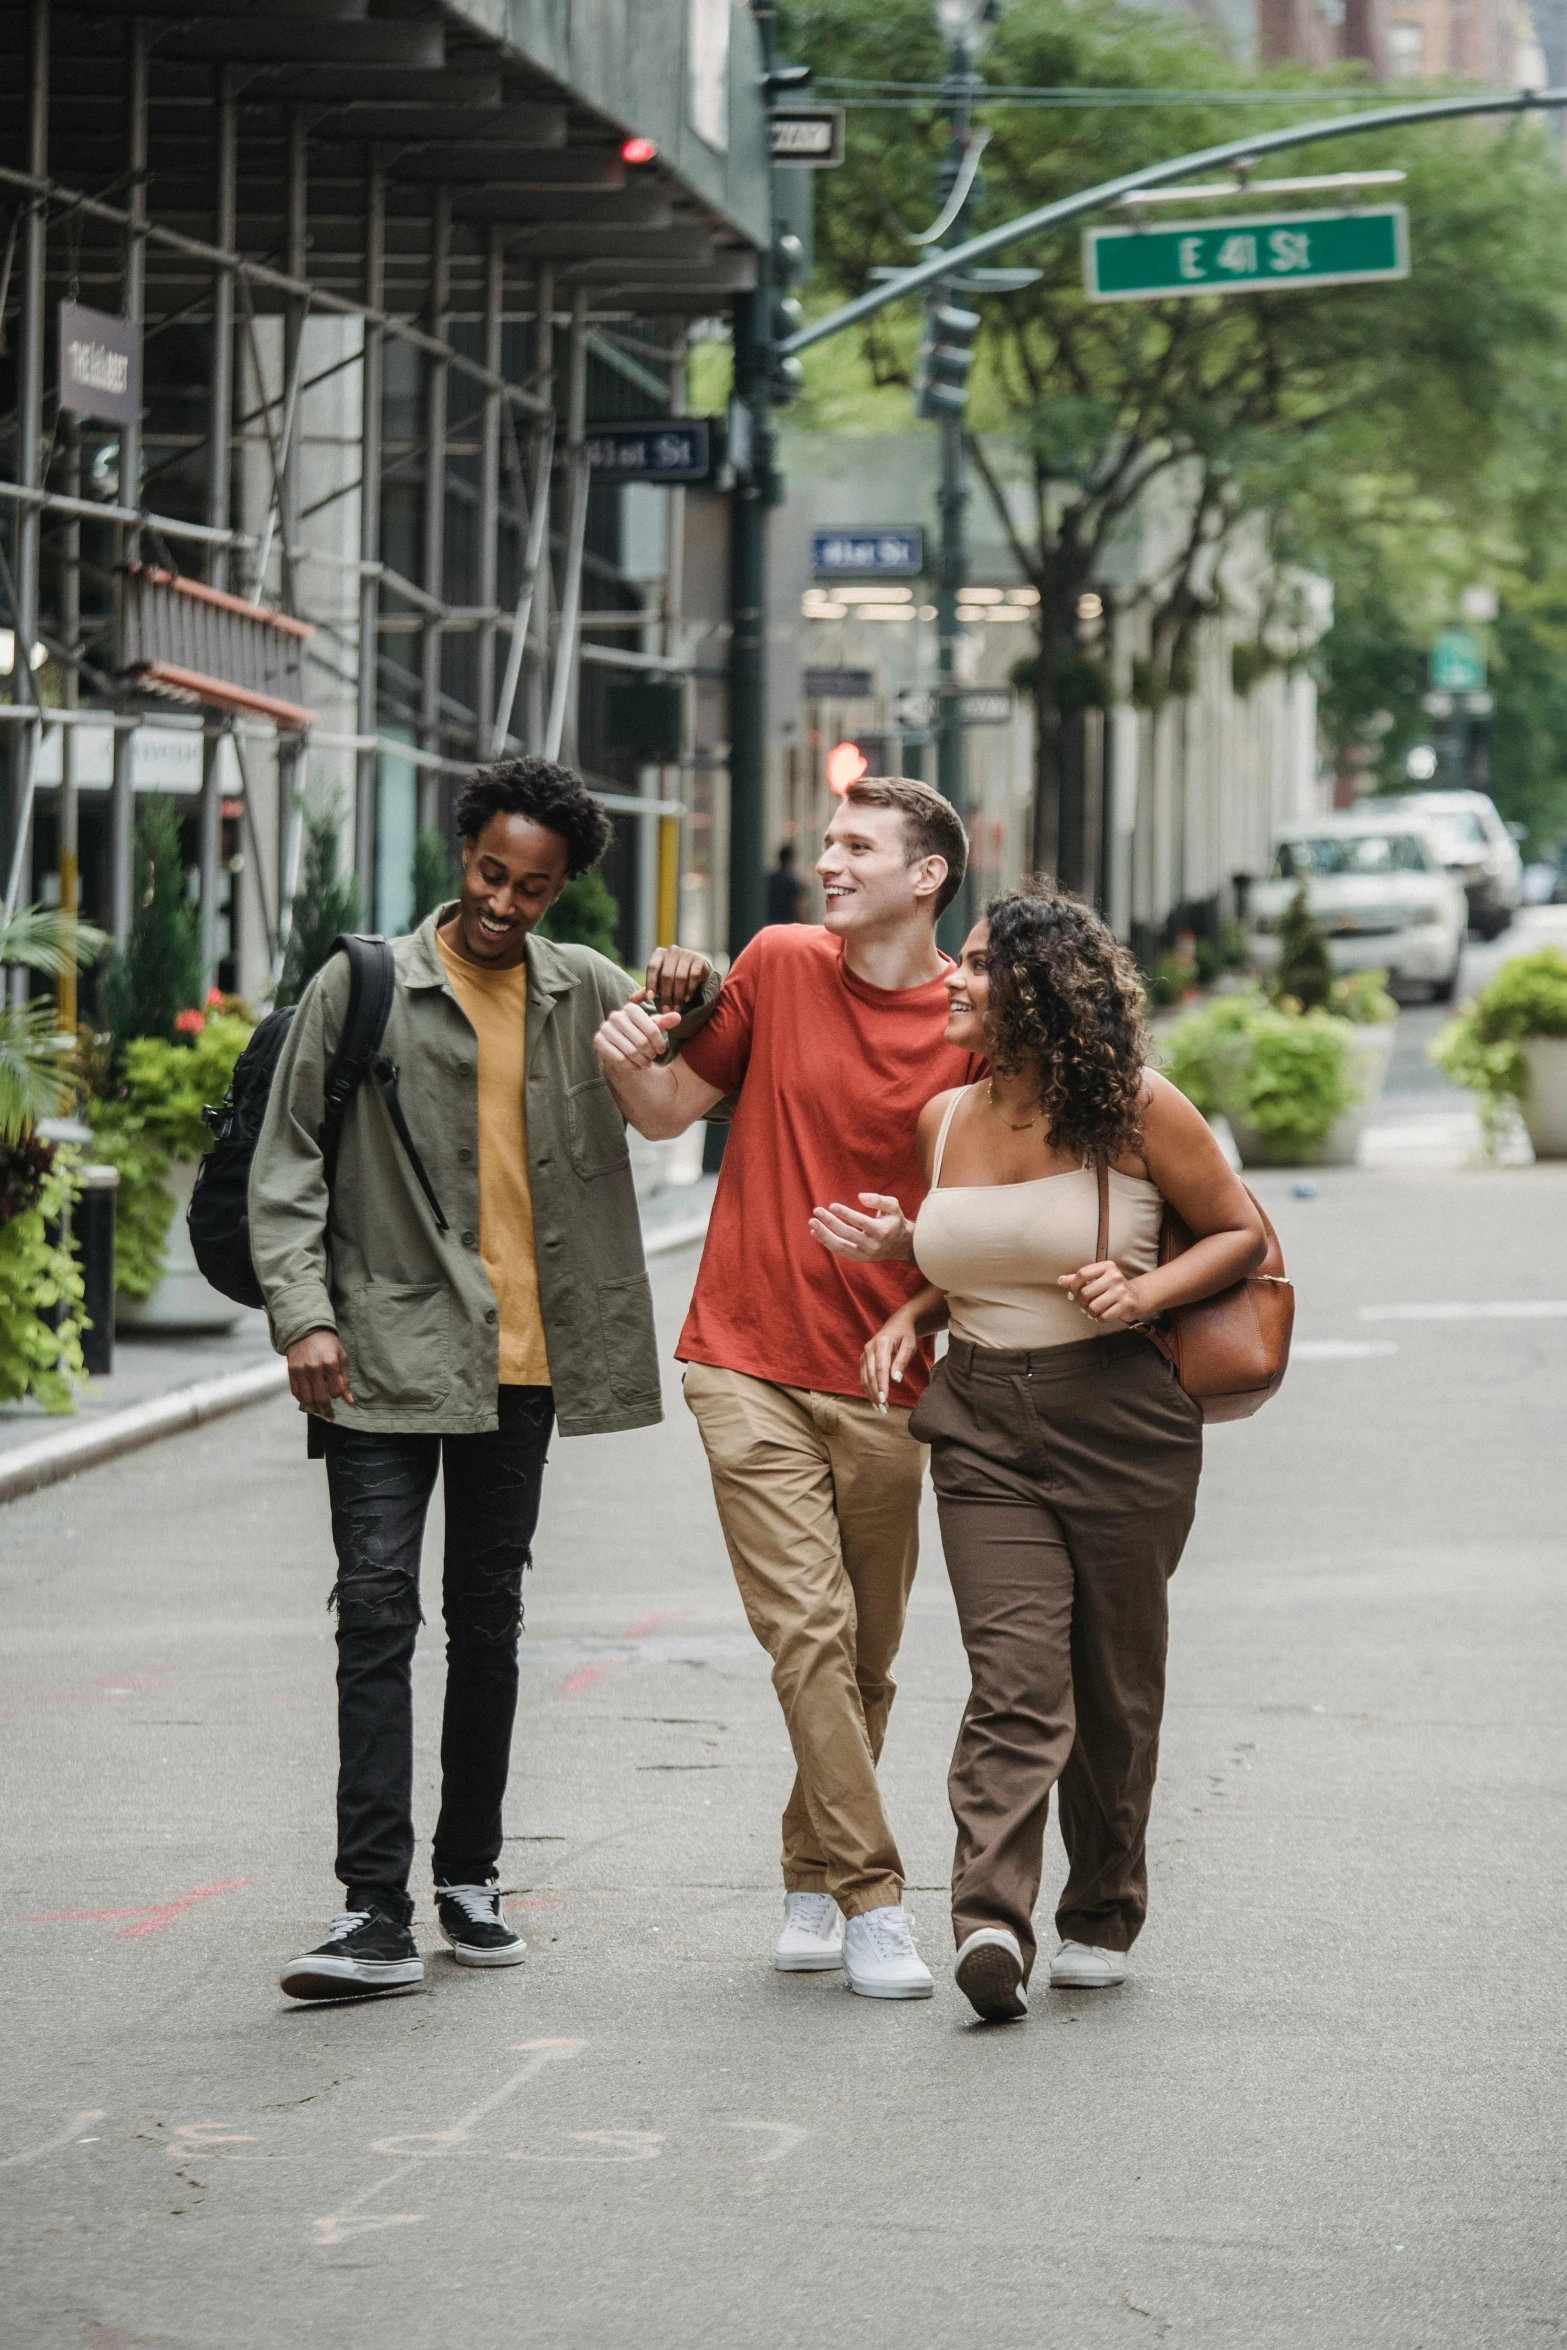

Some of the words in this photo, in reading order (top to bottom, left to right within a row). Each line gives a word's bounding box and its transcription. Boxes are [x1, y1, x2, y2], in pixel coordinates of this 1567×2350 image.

[1179, 237, 1206, 279] E
[1216, 234, 1258, 274] 41
[1267, 230, 1312, 272] St
[654, 433, 691, 469] St
[878, 536, 909, 567] St
